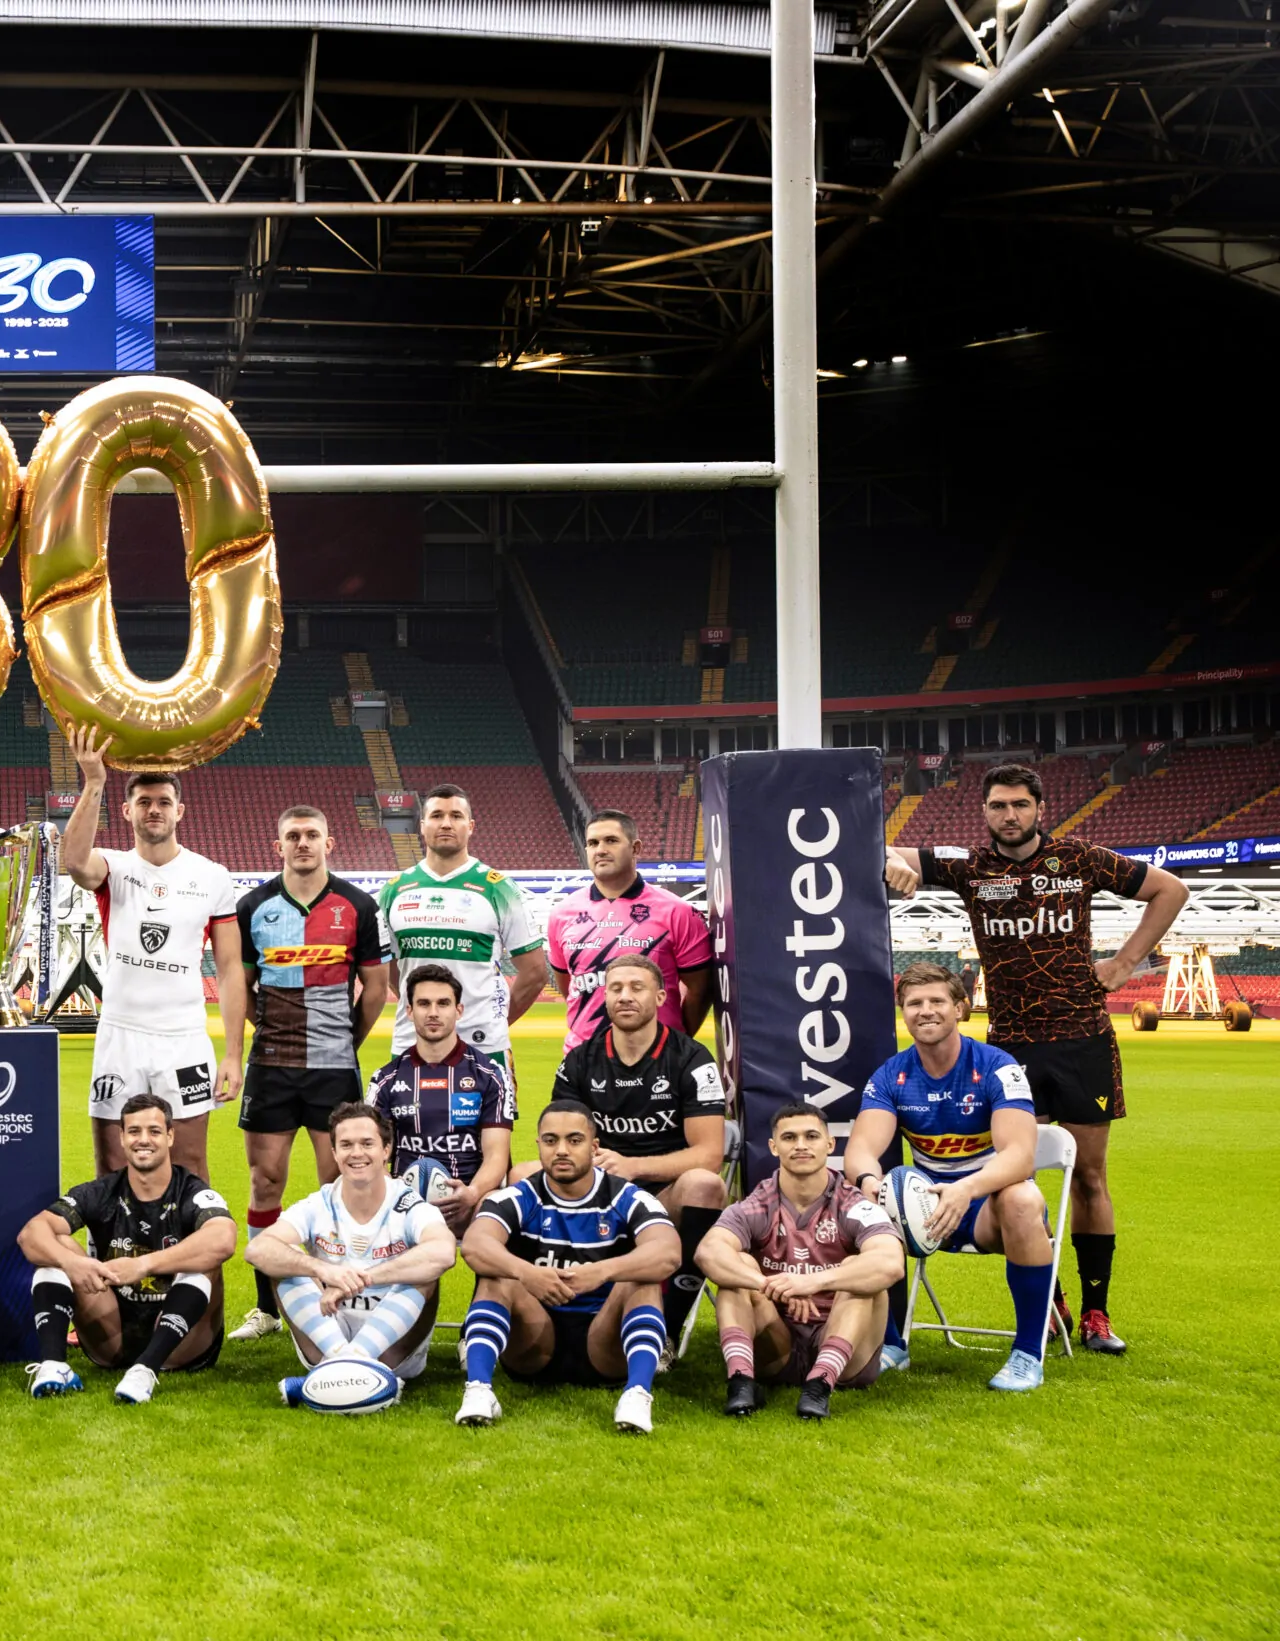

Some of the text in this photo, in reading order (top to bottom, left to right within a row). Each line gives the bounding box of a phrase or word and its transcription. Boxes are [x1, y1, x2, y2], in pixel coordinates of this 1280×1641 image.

[1197, 668, 1243, 681] Principality
[57, 796, 75, 805] 440
[387, 795, 404, 804] 441
[1167, 849, 1210, 861] CHAMPIONS
[1210, 847, 1225, 858] CUP
[1050, 876, 1084, 889] Théa
[434, 916, 467, 924] Cucine
[982, 907, 1073, 939] implid
[400, 937, 472, 951] PROSECCO DOC
[274, 949, 332, 963] DHL
[116, 953, 190, 974] PEUGEOT
[421, 1079, 446, 1088] Betclic
[615, 1077, 644, 1088] StoneX
[927, 1091, 952, 1102] BLK
[911, 1136, 988, 1154] DHL
[320, 1377, 370, 1389] Investec
